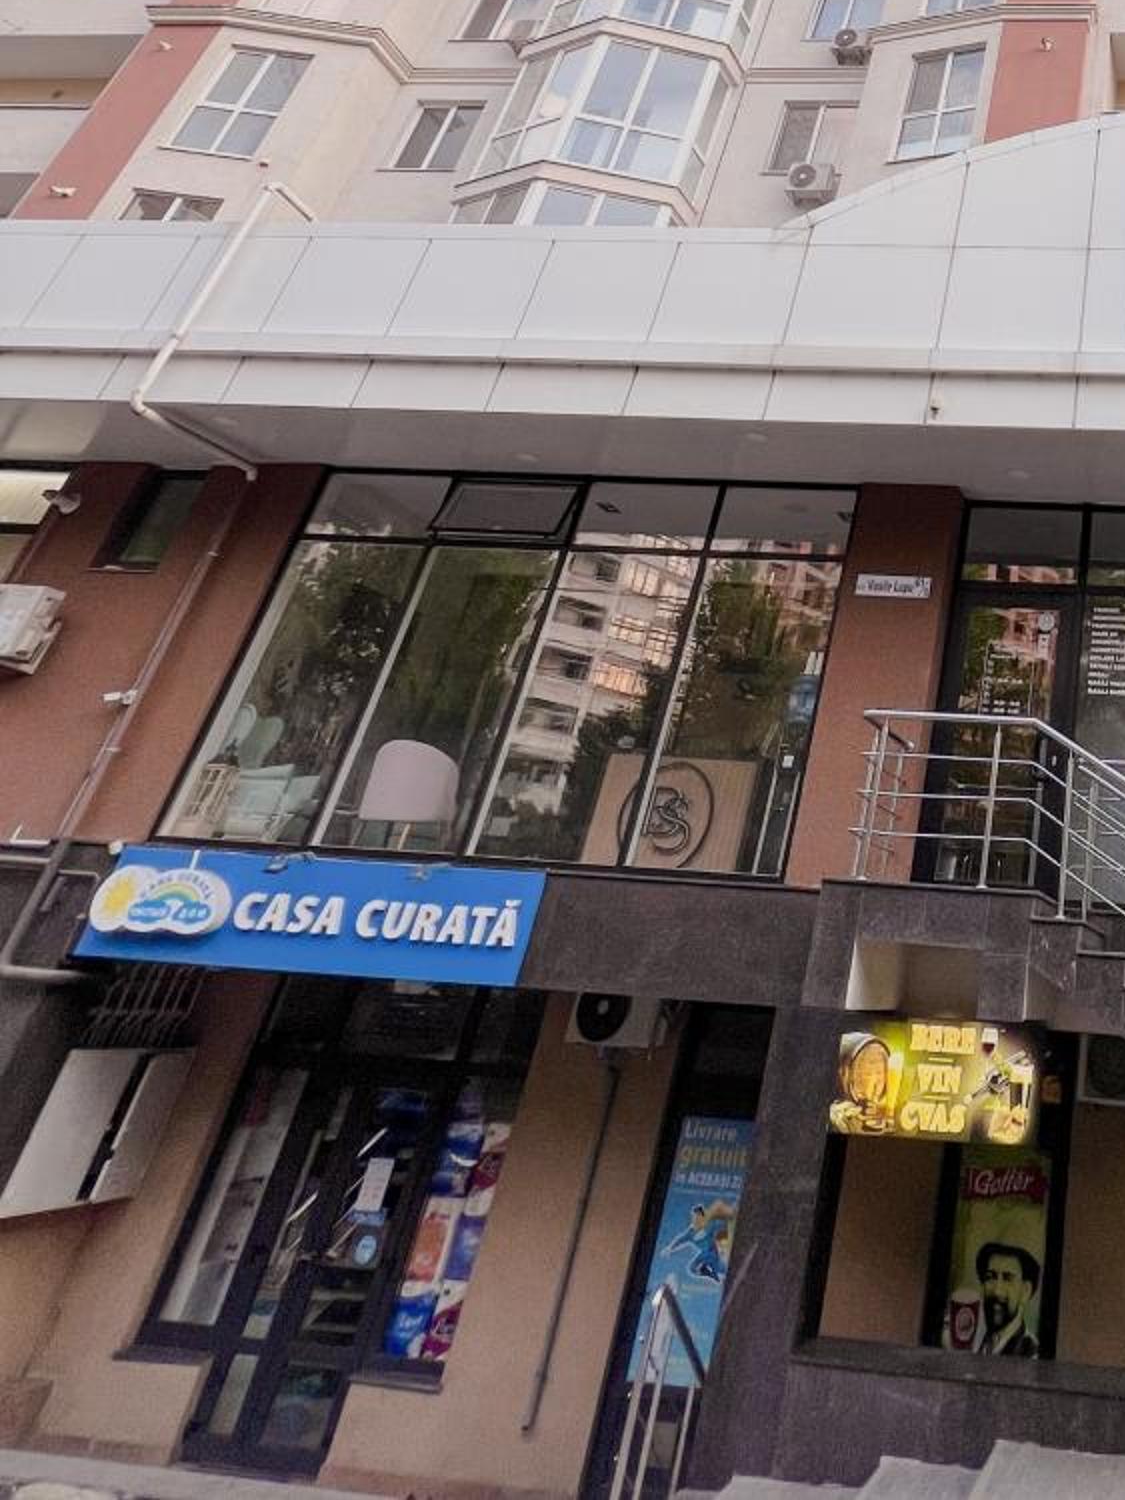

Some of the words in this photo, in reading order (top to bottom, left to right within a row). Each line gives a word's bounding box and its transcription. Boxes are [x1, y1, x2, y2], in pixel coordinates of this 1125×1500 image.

[233, 891, 345, 936] CASA
[355, 899, 523, 947] CURATĂ
[910, 1023, 977, 1055] BERE
[917, 1063, 962, 1094] VIN
[900, 1100, 968, 1134] CVAS
